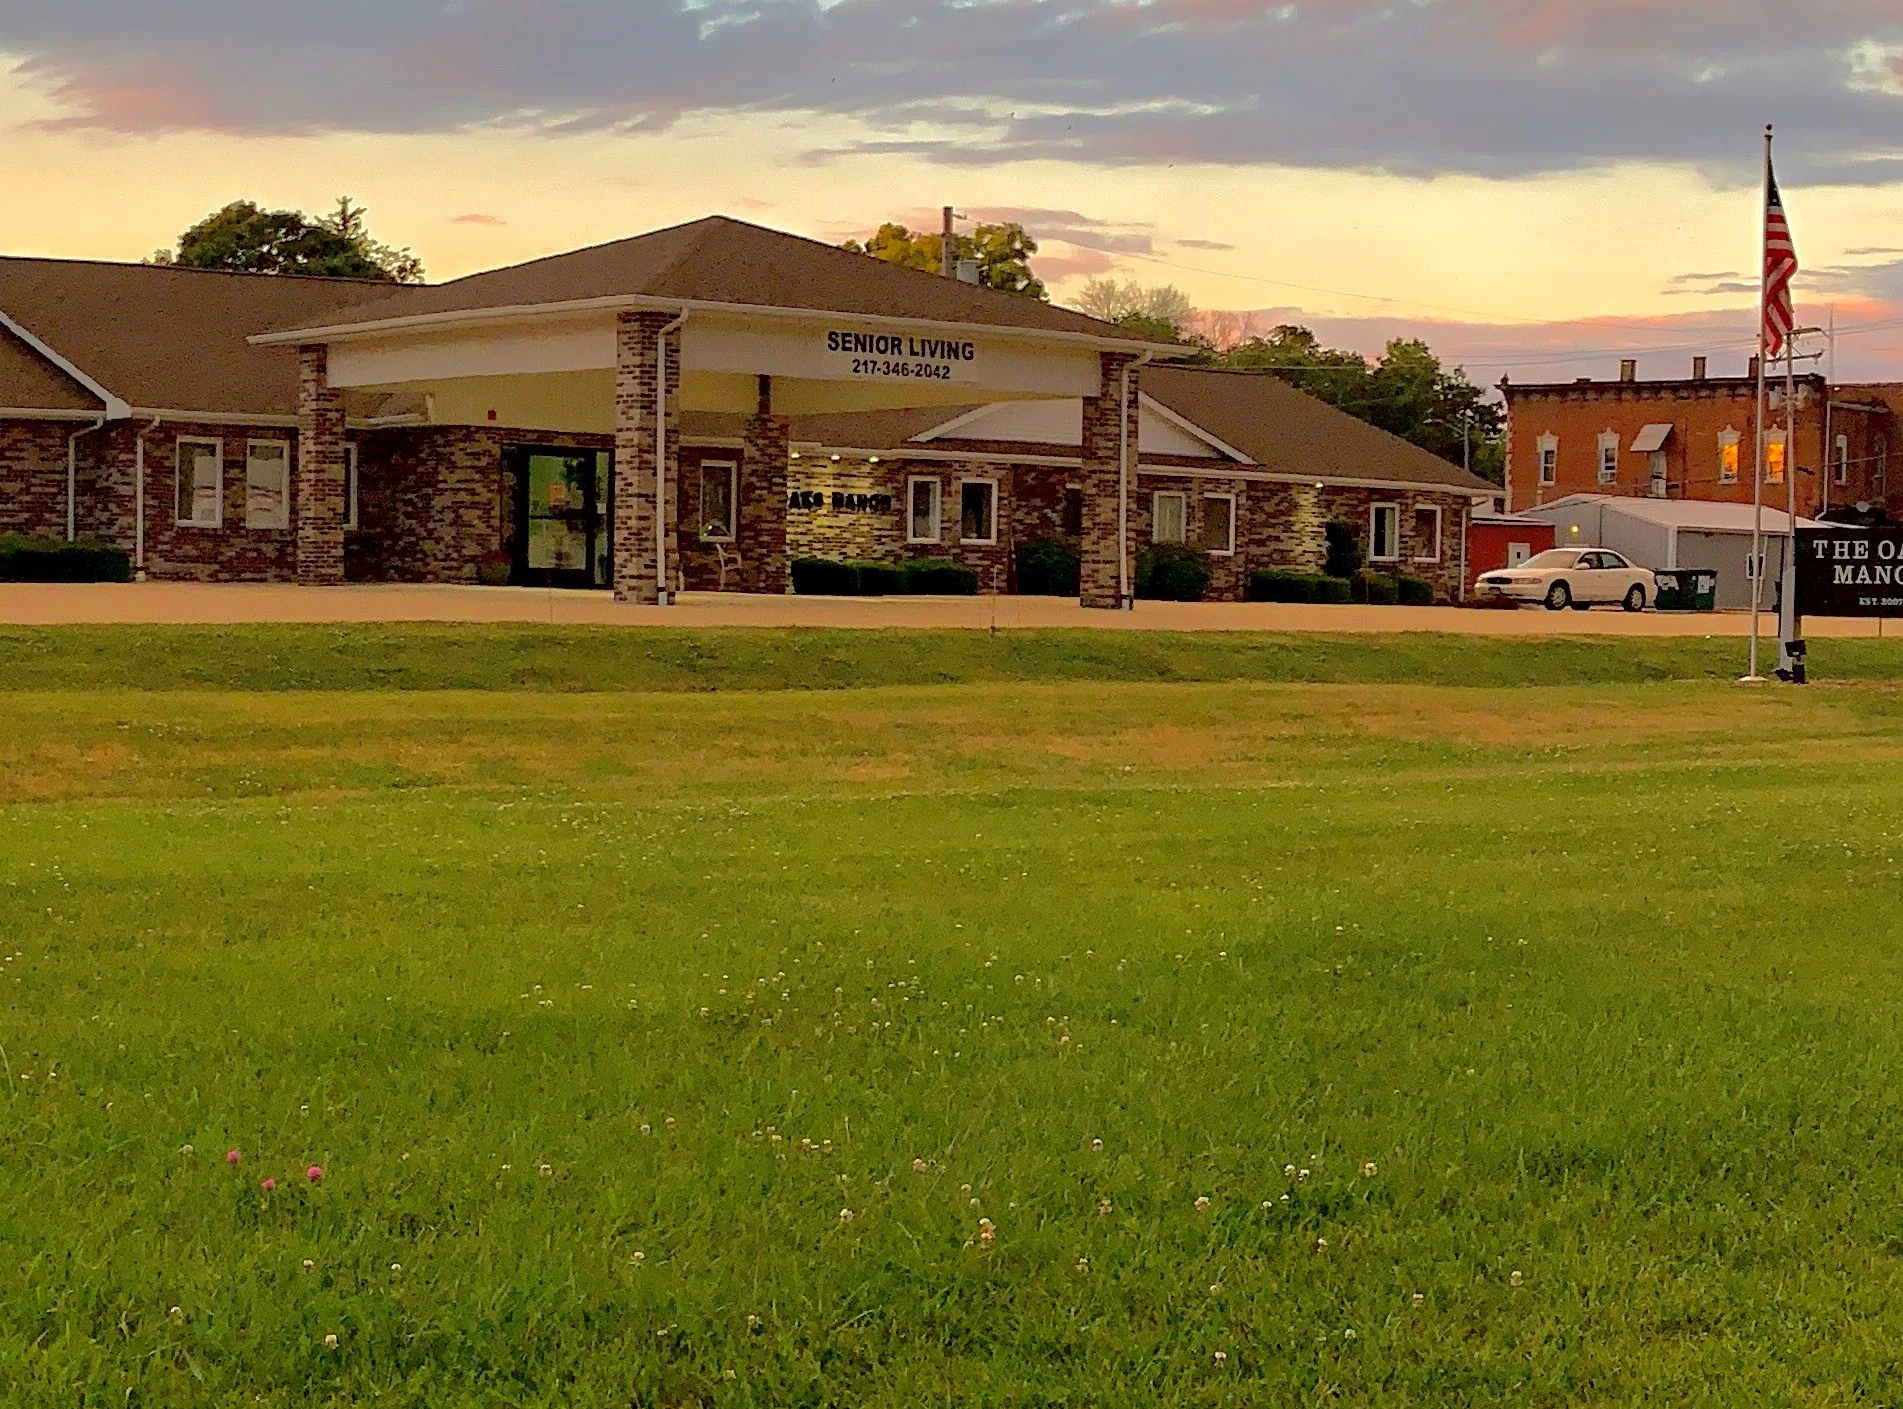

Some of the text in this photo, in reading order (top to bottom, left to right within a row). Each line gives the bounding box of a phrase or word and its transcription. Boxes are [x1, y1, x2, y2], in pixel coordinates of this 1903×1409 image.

[827, 331, 975, 361] SENIOR LIVING
[852, 358, 951, 380] 217-346-2042
[1812, 539, 1869, 560] THE
